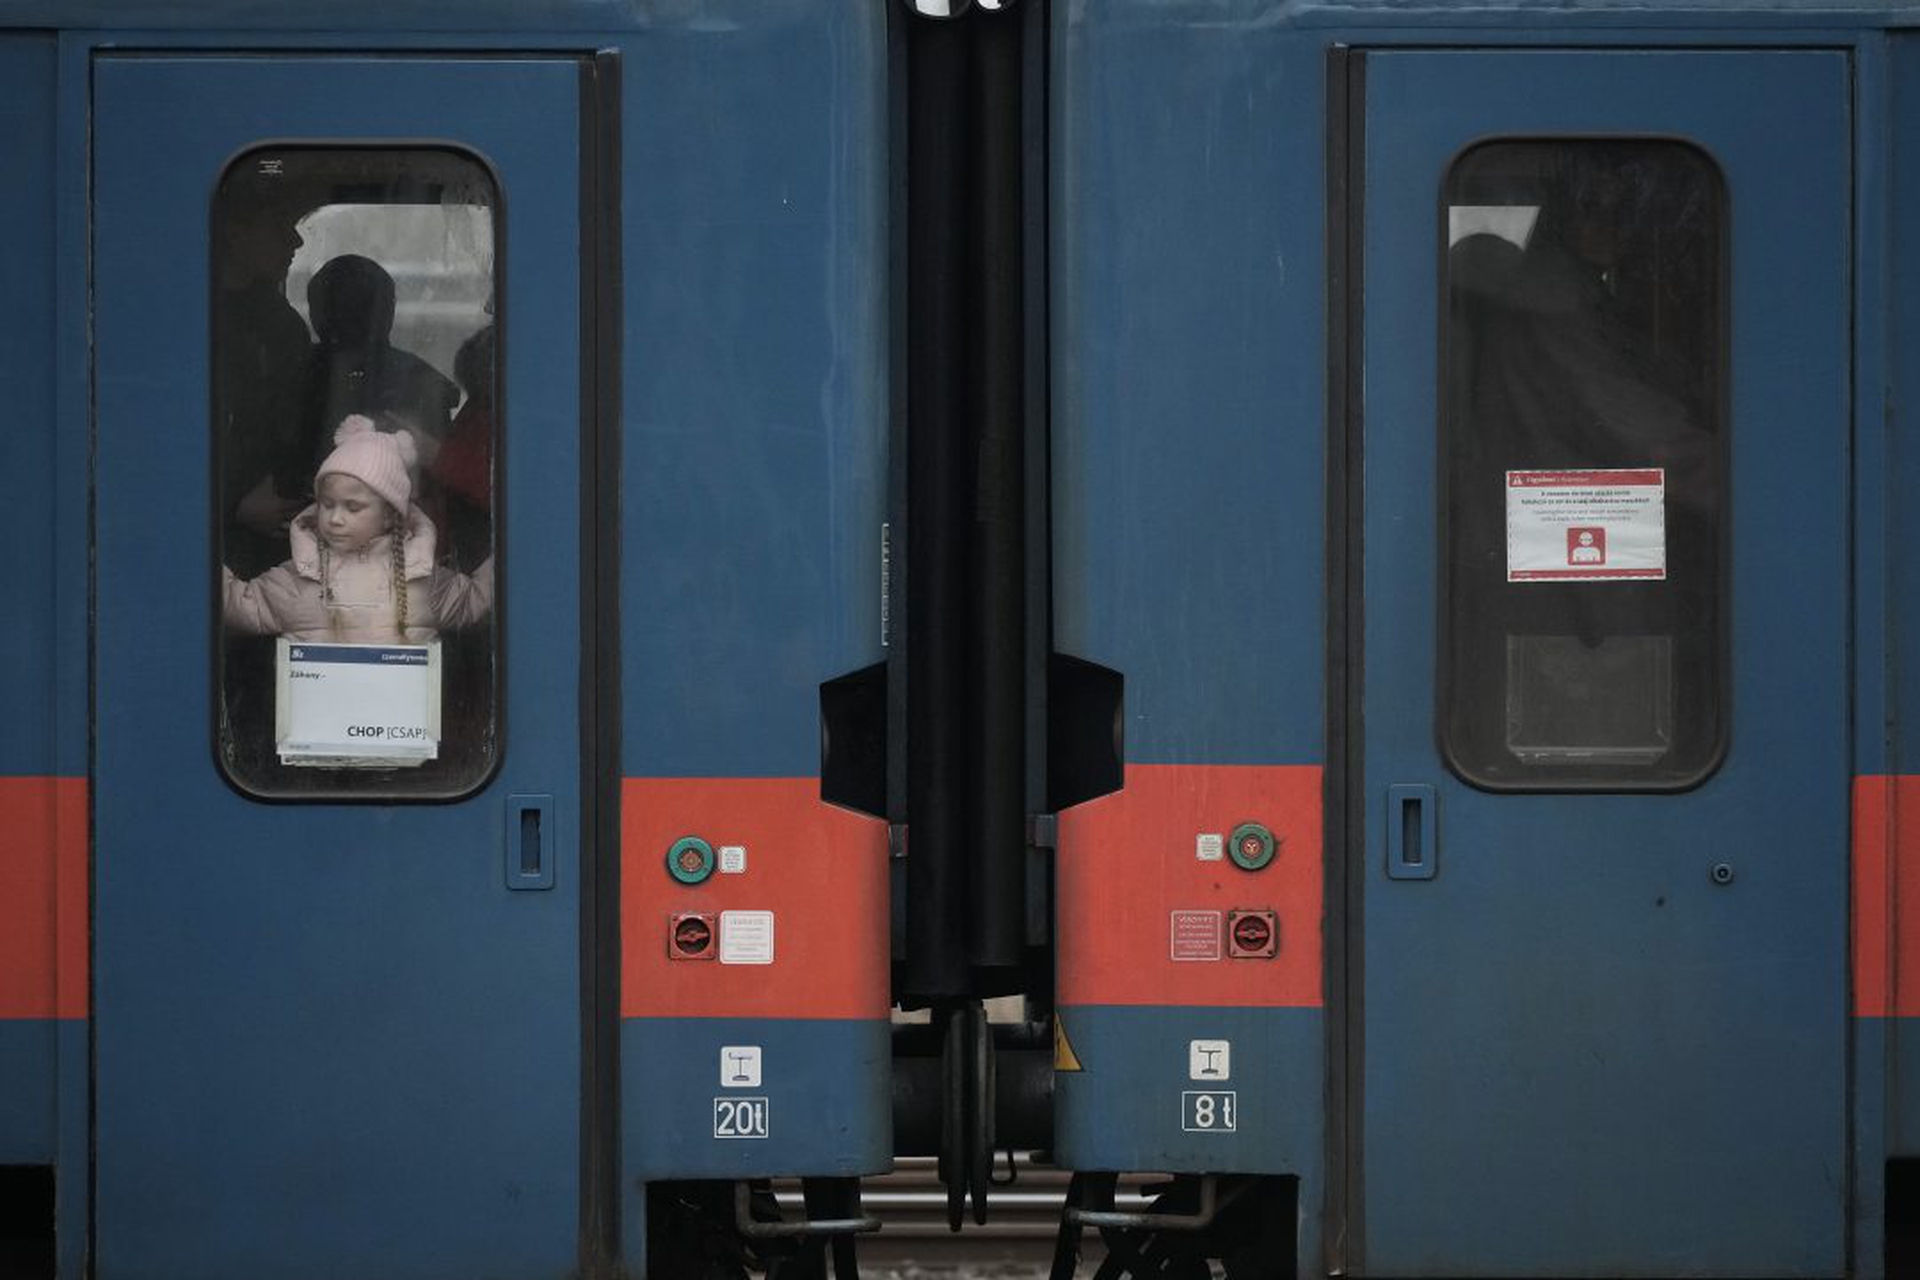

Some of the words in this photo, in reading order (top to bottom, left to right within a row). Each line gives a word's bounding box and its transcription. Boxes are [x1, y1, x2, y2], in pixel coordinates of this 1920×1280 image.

[347, 726, 384, 737] CHOP
[718, 1101, 765, 1135] 20t
[1196, 1095, 1214, 1128] 8
